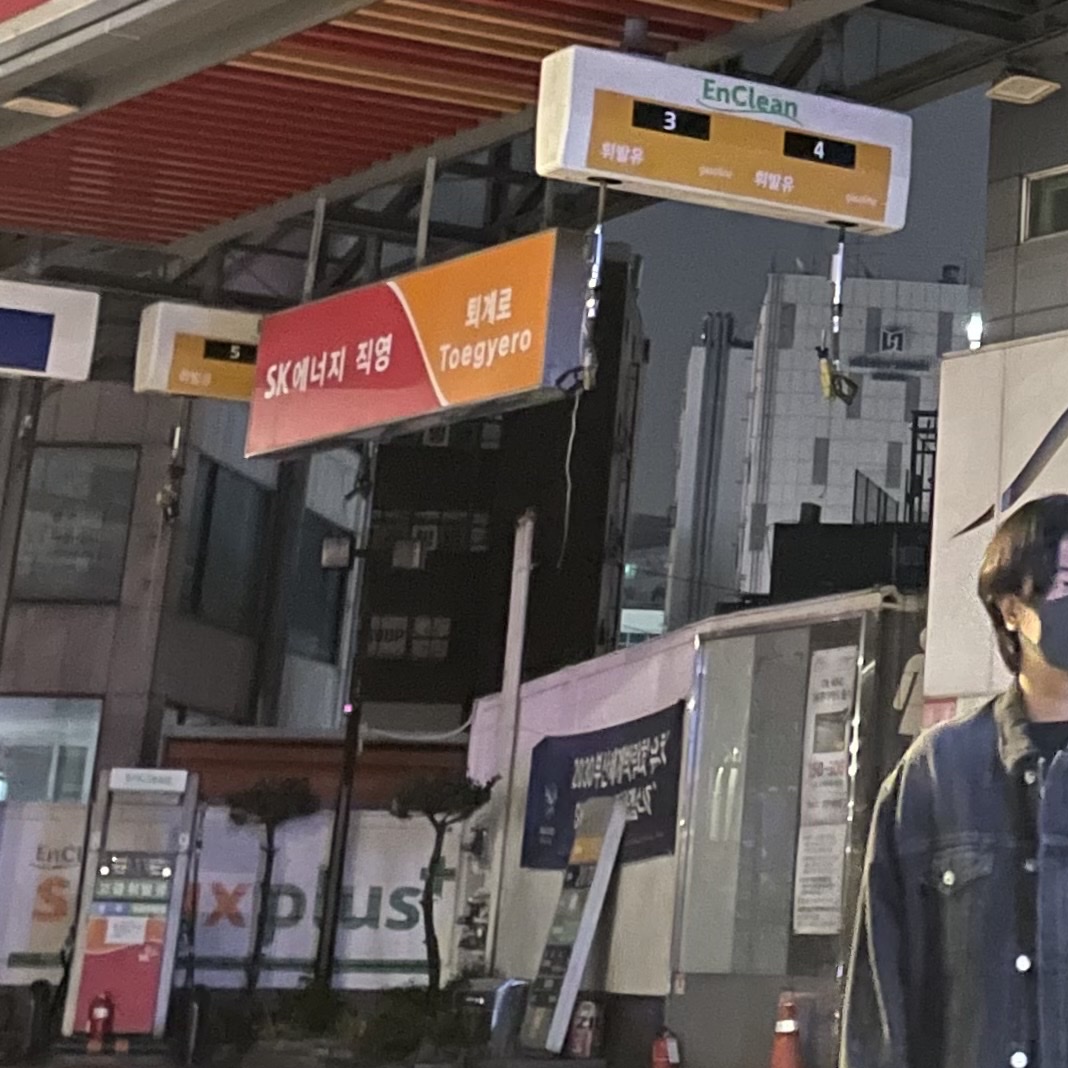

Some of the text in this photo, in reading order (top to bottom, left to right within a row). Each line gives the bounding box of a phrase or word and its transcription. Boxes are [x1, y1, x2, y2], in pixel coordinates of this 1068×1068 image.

[703, 78, 798, 118] EnClean
[664, 111, 676, 131] 3
[813, 141, 825, 160] 4
[465, 287, 512, 328] 퇴계로
[230, 344, 240, 359] 5
[355, 333, 393, 376] 직영
[439, 329, 532, 372] Toegyero
